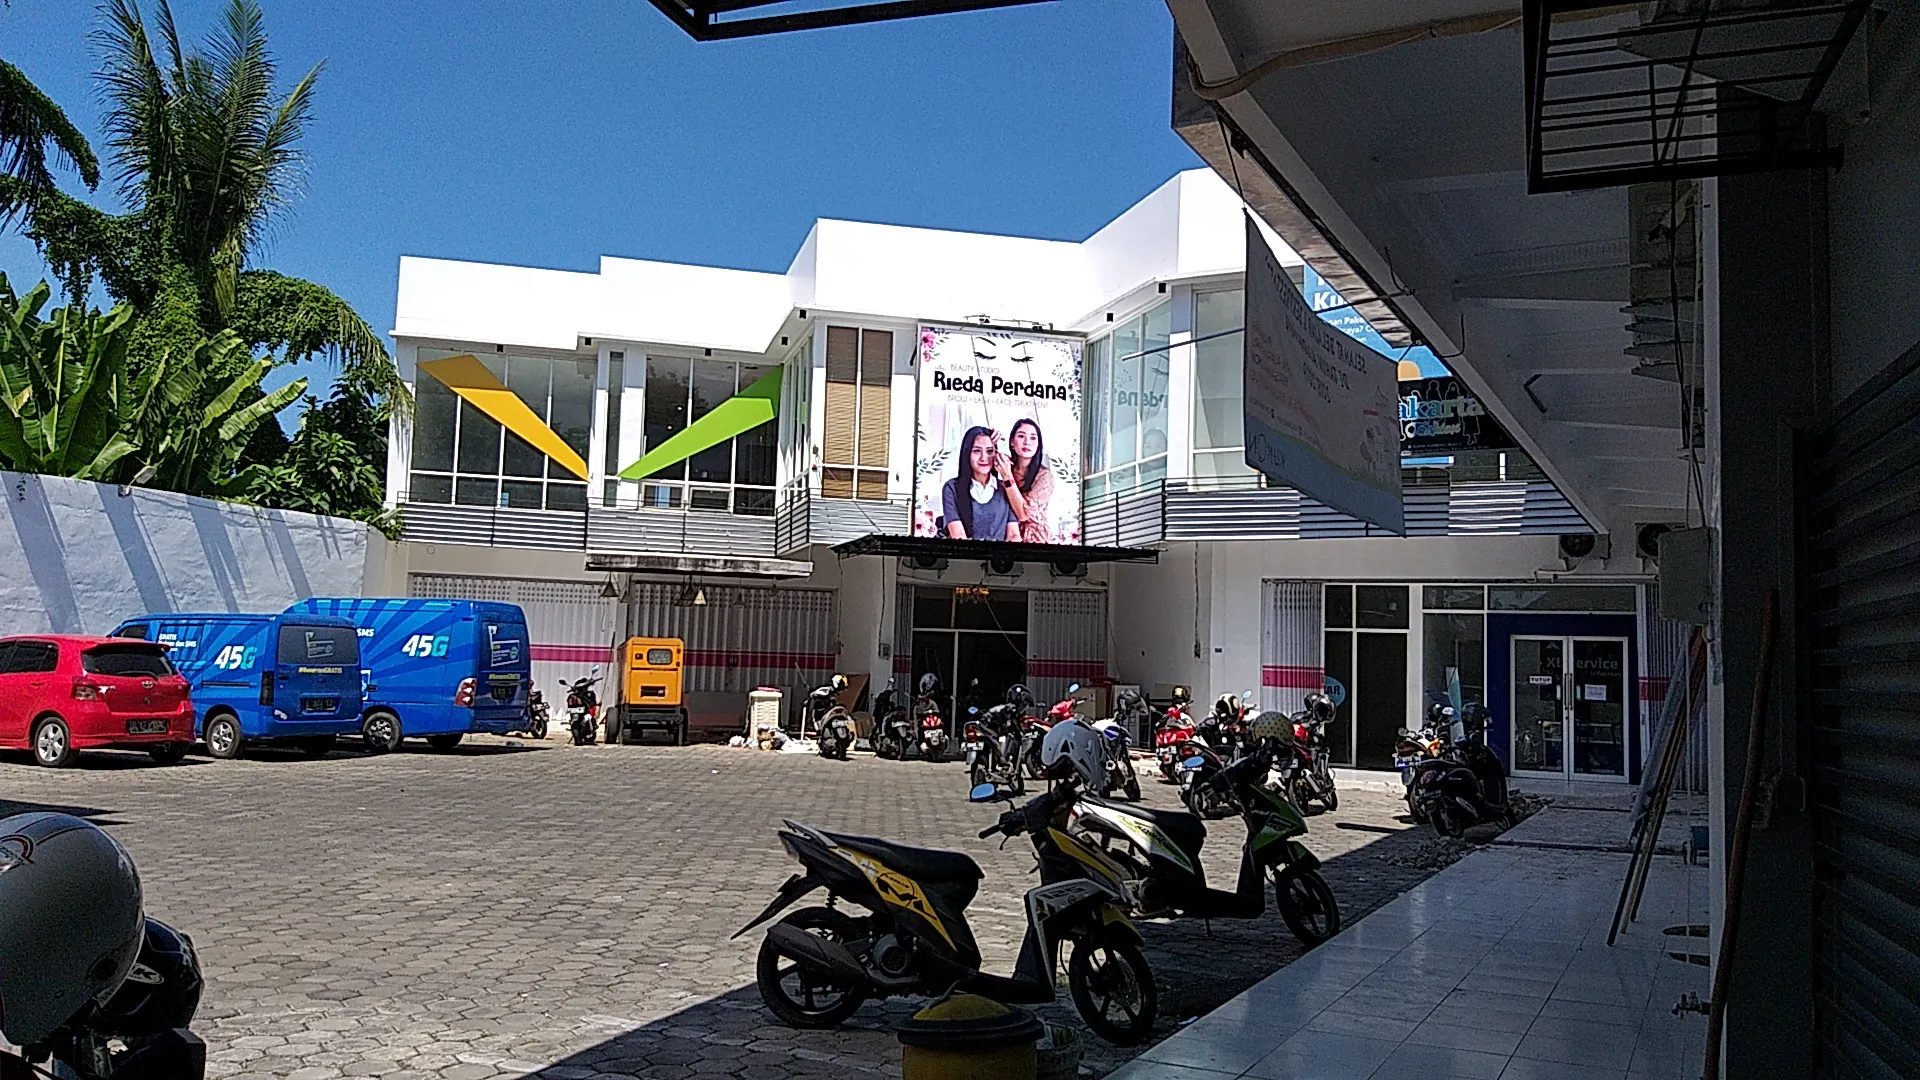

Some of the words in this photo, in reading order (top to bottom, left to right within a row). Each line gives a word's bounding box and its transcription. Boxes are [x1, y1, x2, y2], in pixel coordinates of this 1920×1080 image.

[1314, 291, 1348, 311] Ku
[934, 371, 983, 394] Rieda
[991, 376, 1067, 401] Perdana
[1399, 396, 1486, 420] akarta
[1576, 657, 1618, 670] ervice
